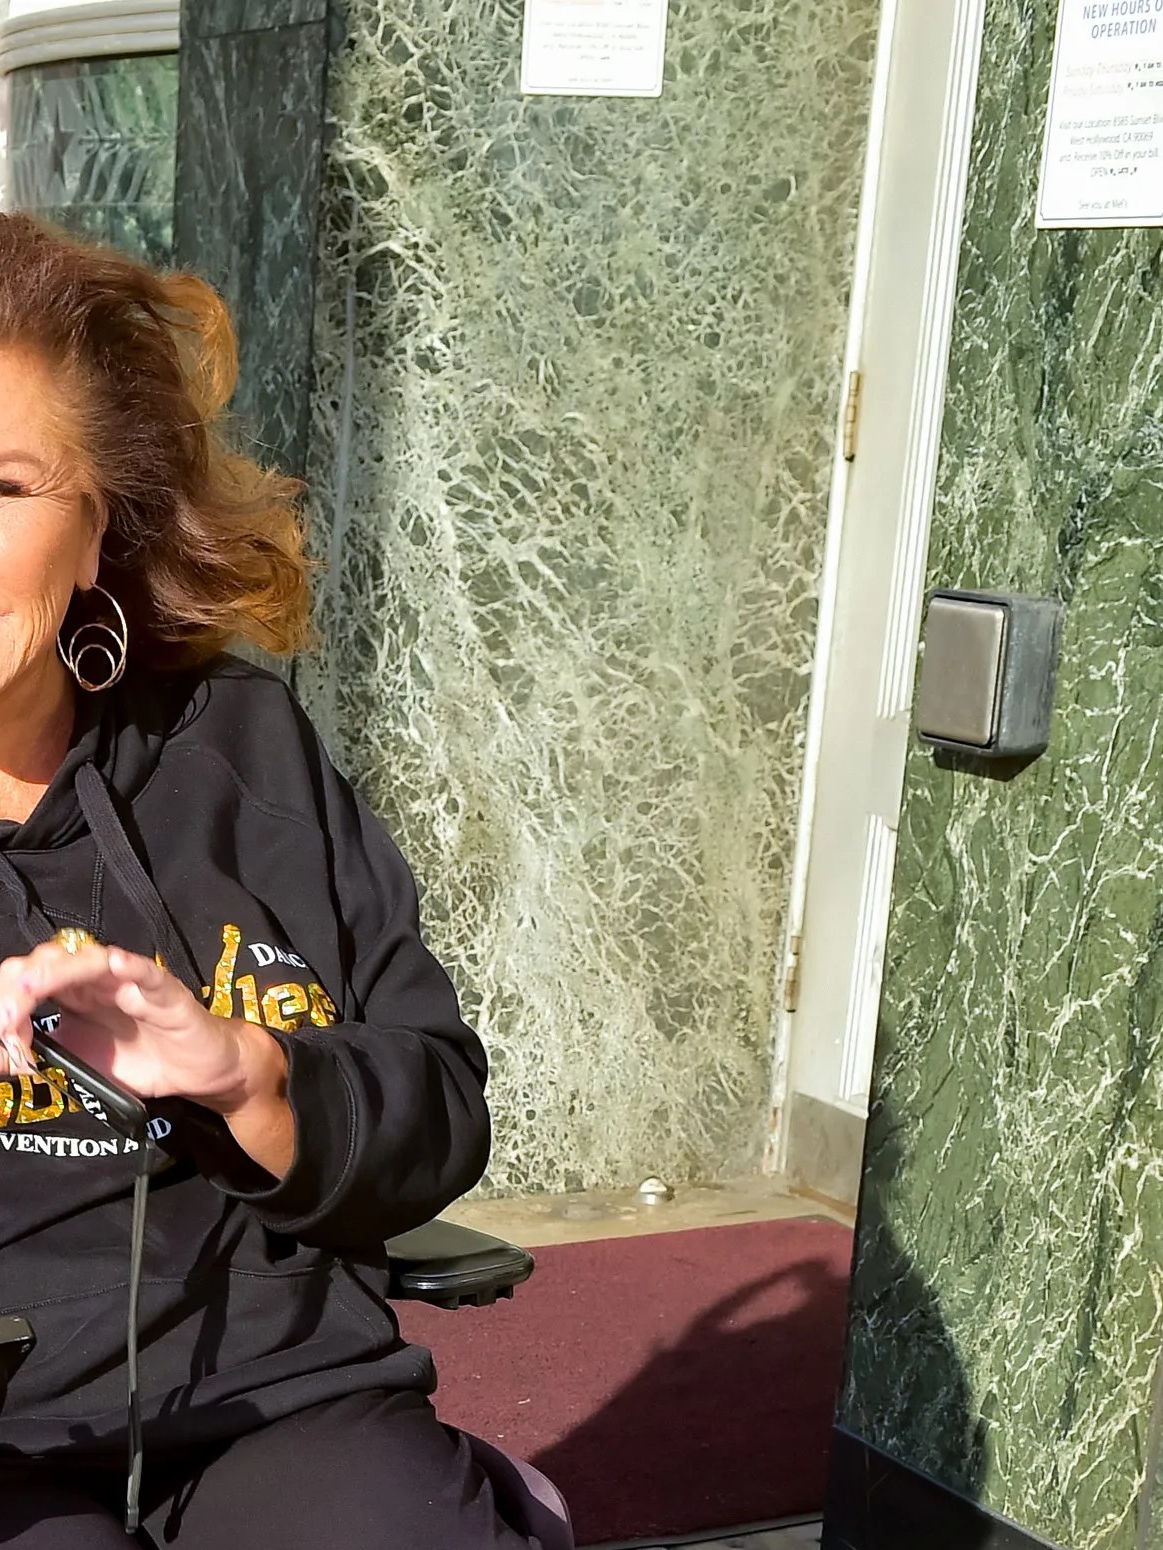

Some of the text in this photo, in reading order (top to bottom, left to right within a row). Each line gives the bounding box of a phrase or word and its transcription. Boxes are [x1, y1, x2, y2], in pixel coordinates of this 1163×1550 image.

[1083, 3, 1108, 19] NEW
[1111, 0, 1151, 16] HOURS
[1091, 18, 1157, 39] OPERATION
